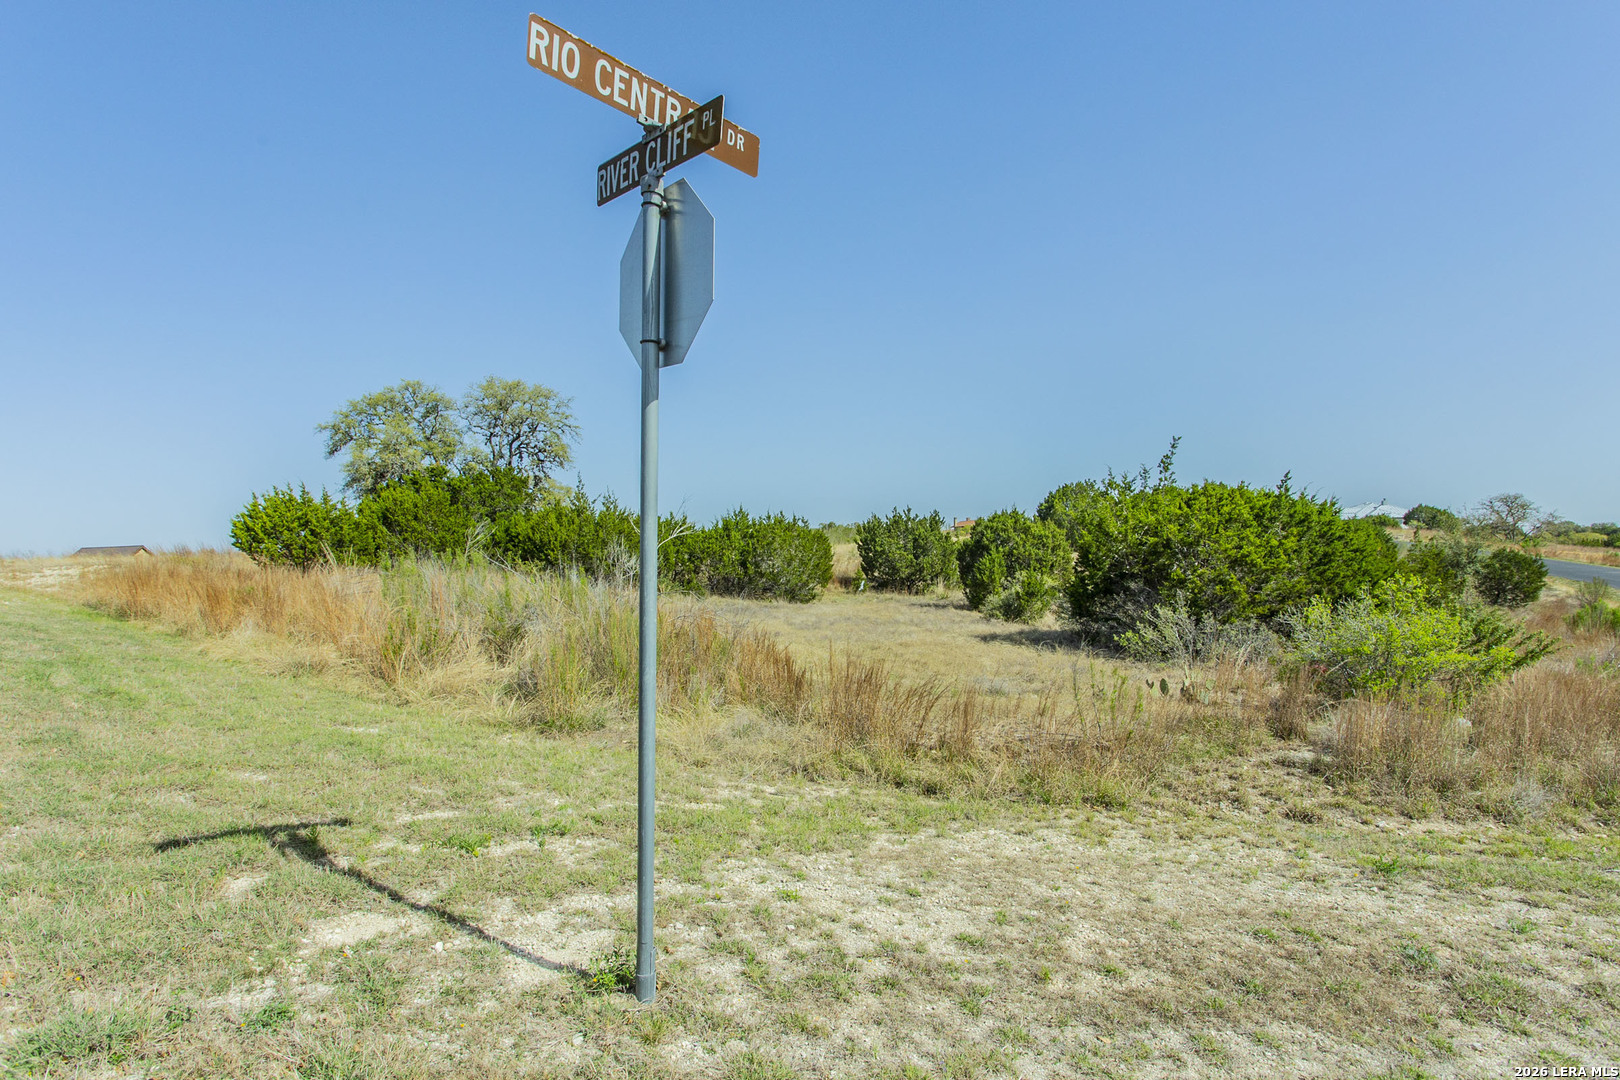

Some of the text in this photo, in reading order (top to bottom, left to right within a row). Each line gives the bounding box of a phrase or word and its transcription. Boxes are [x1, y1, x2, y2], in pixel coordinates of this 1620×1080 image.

[529, 20, 745, 152] RIO CENTR DR
[597, 108, 716, 201] RIVER CLIFF PL
